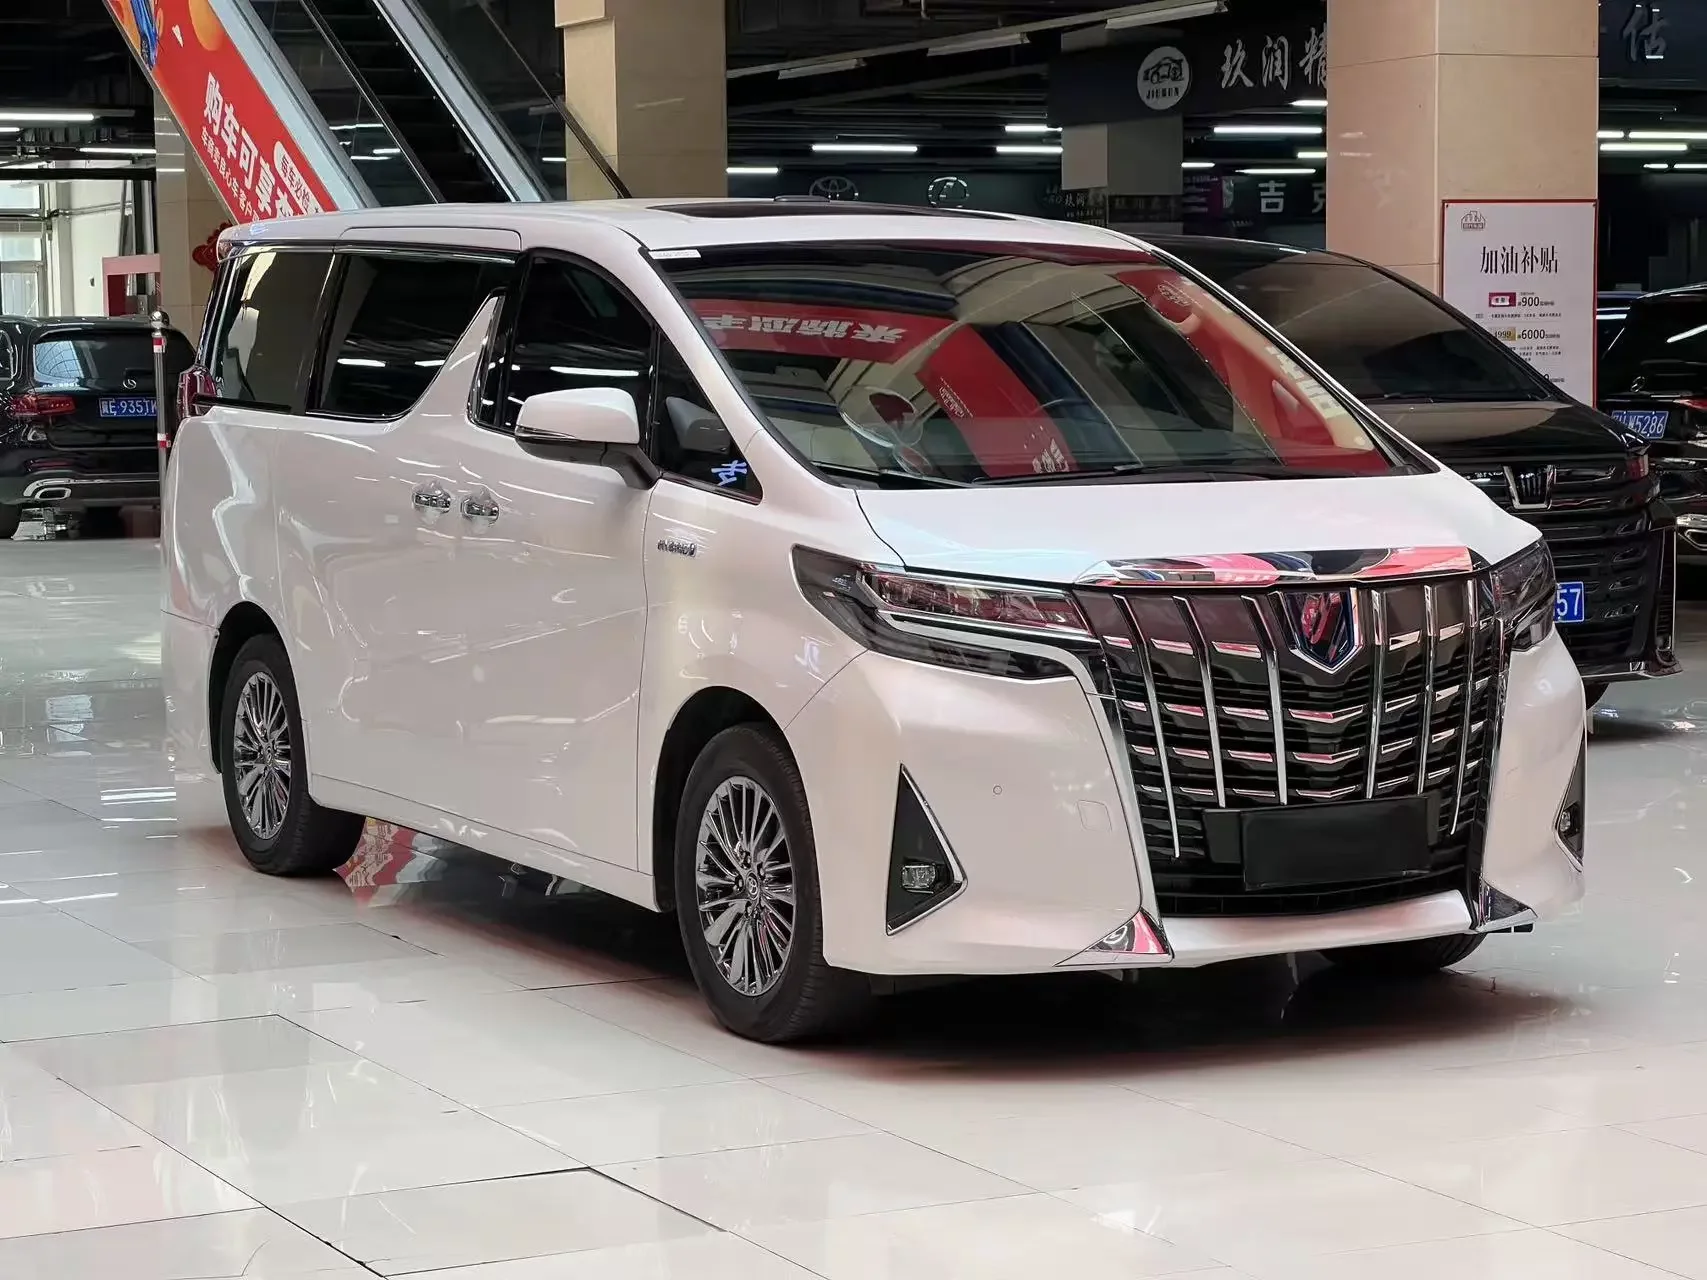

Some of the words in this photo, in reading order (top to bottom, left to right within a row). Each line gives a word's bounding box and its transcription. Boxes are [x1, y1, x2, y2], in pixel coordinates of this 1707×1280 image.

[1480, 245, 1558, 274] 加油补贴
[1521, 297, 1540, 307] 900
[1521, 329, 1545, 340] 6000
